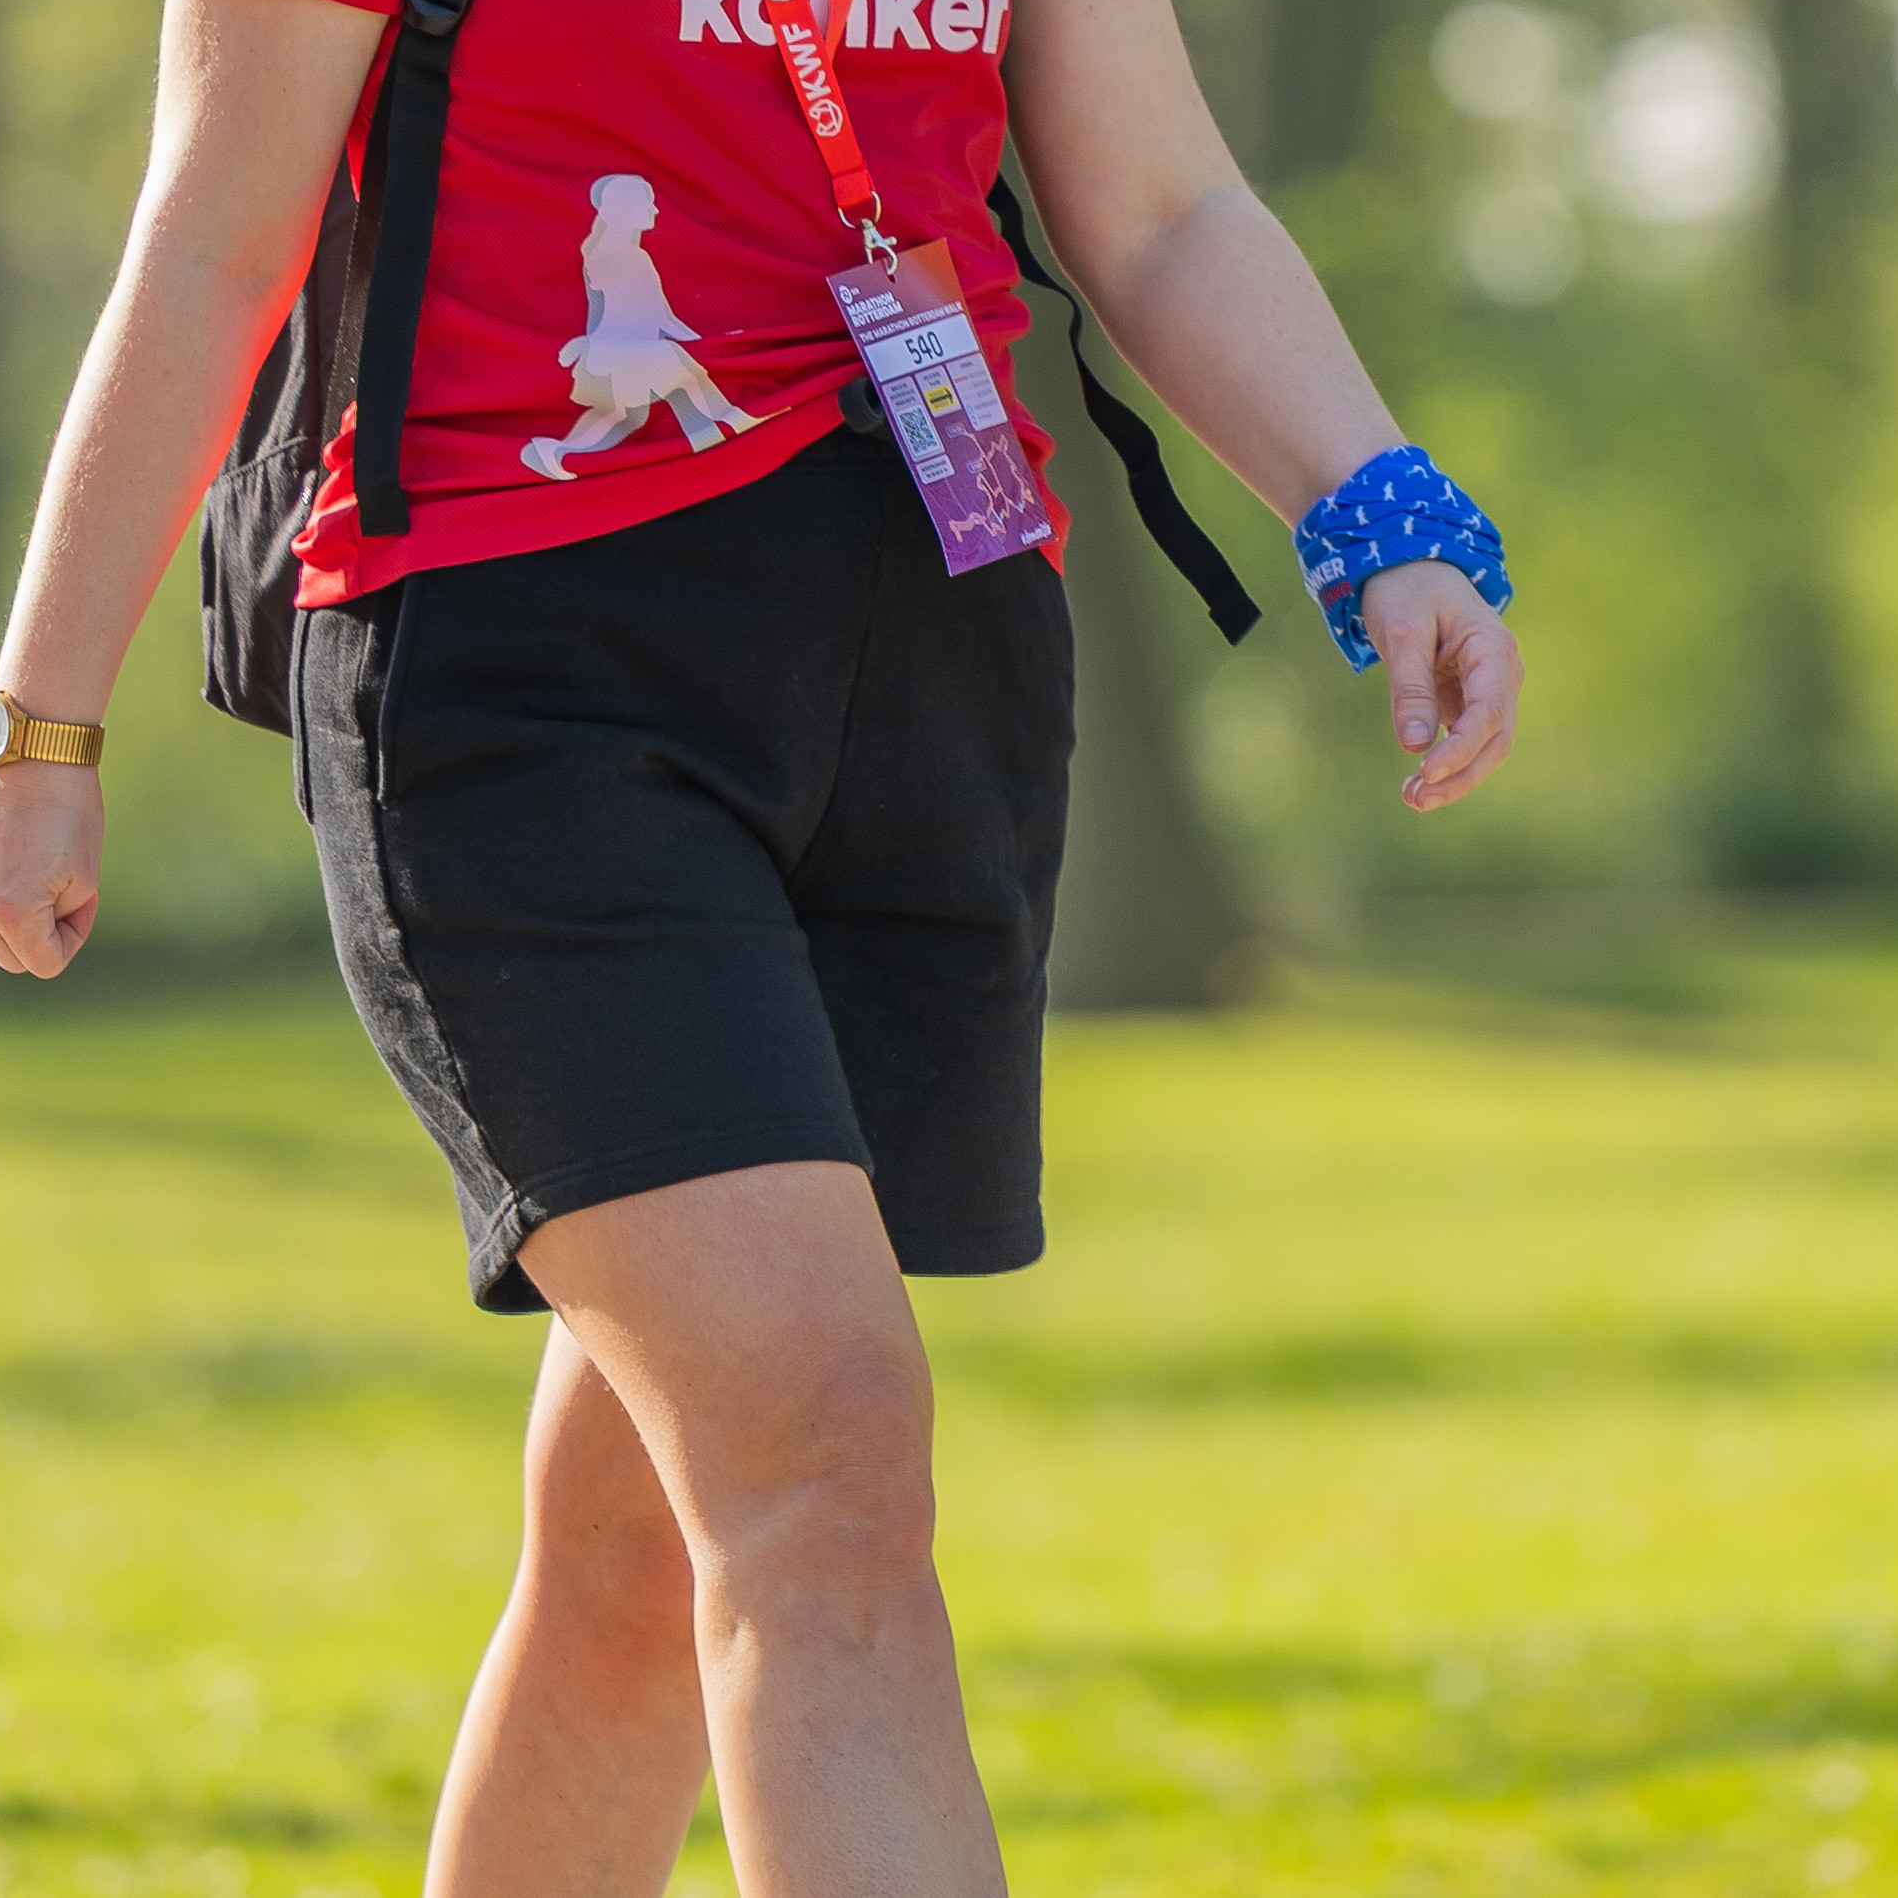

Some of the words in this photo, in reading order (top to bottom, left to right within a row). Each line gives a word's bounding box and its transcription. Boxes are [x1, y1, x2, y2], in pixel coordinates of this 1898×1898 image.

[780, 22, 833, 101] KWF
[846, 290, 896, 317] MARATHON
[851, 301, 904, 329] ROTTERDAM
[904, 330, 945, 365] 540
